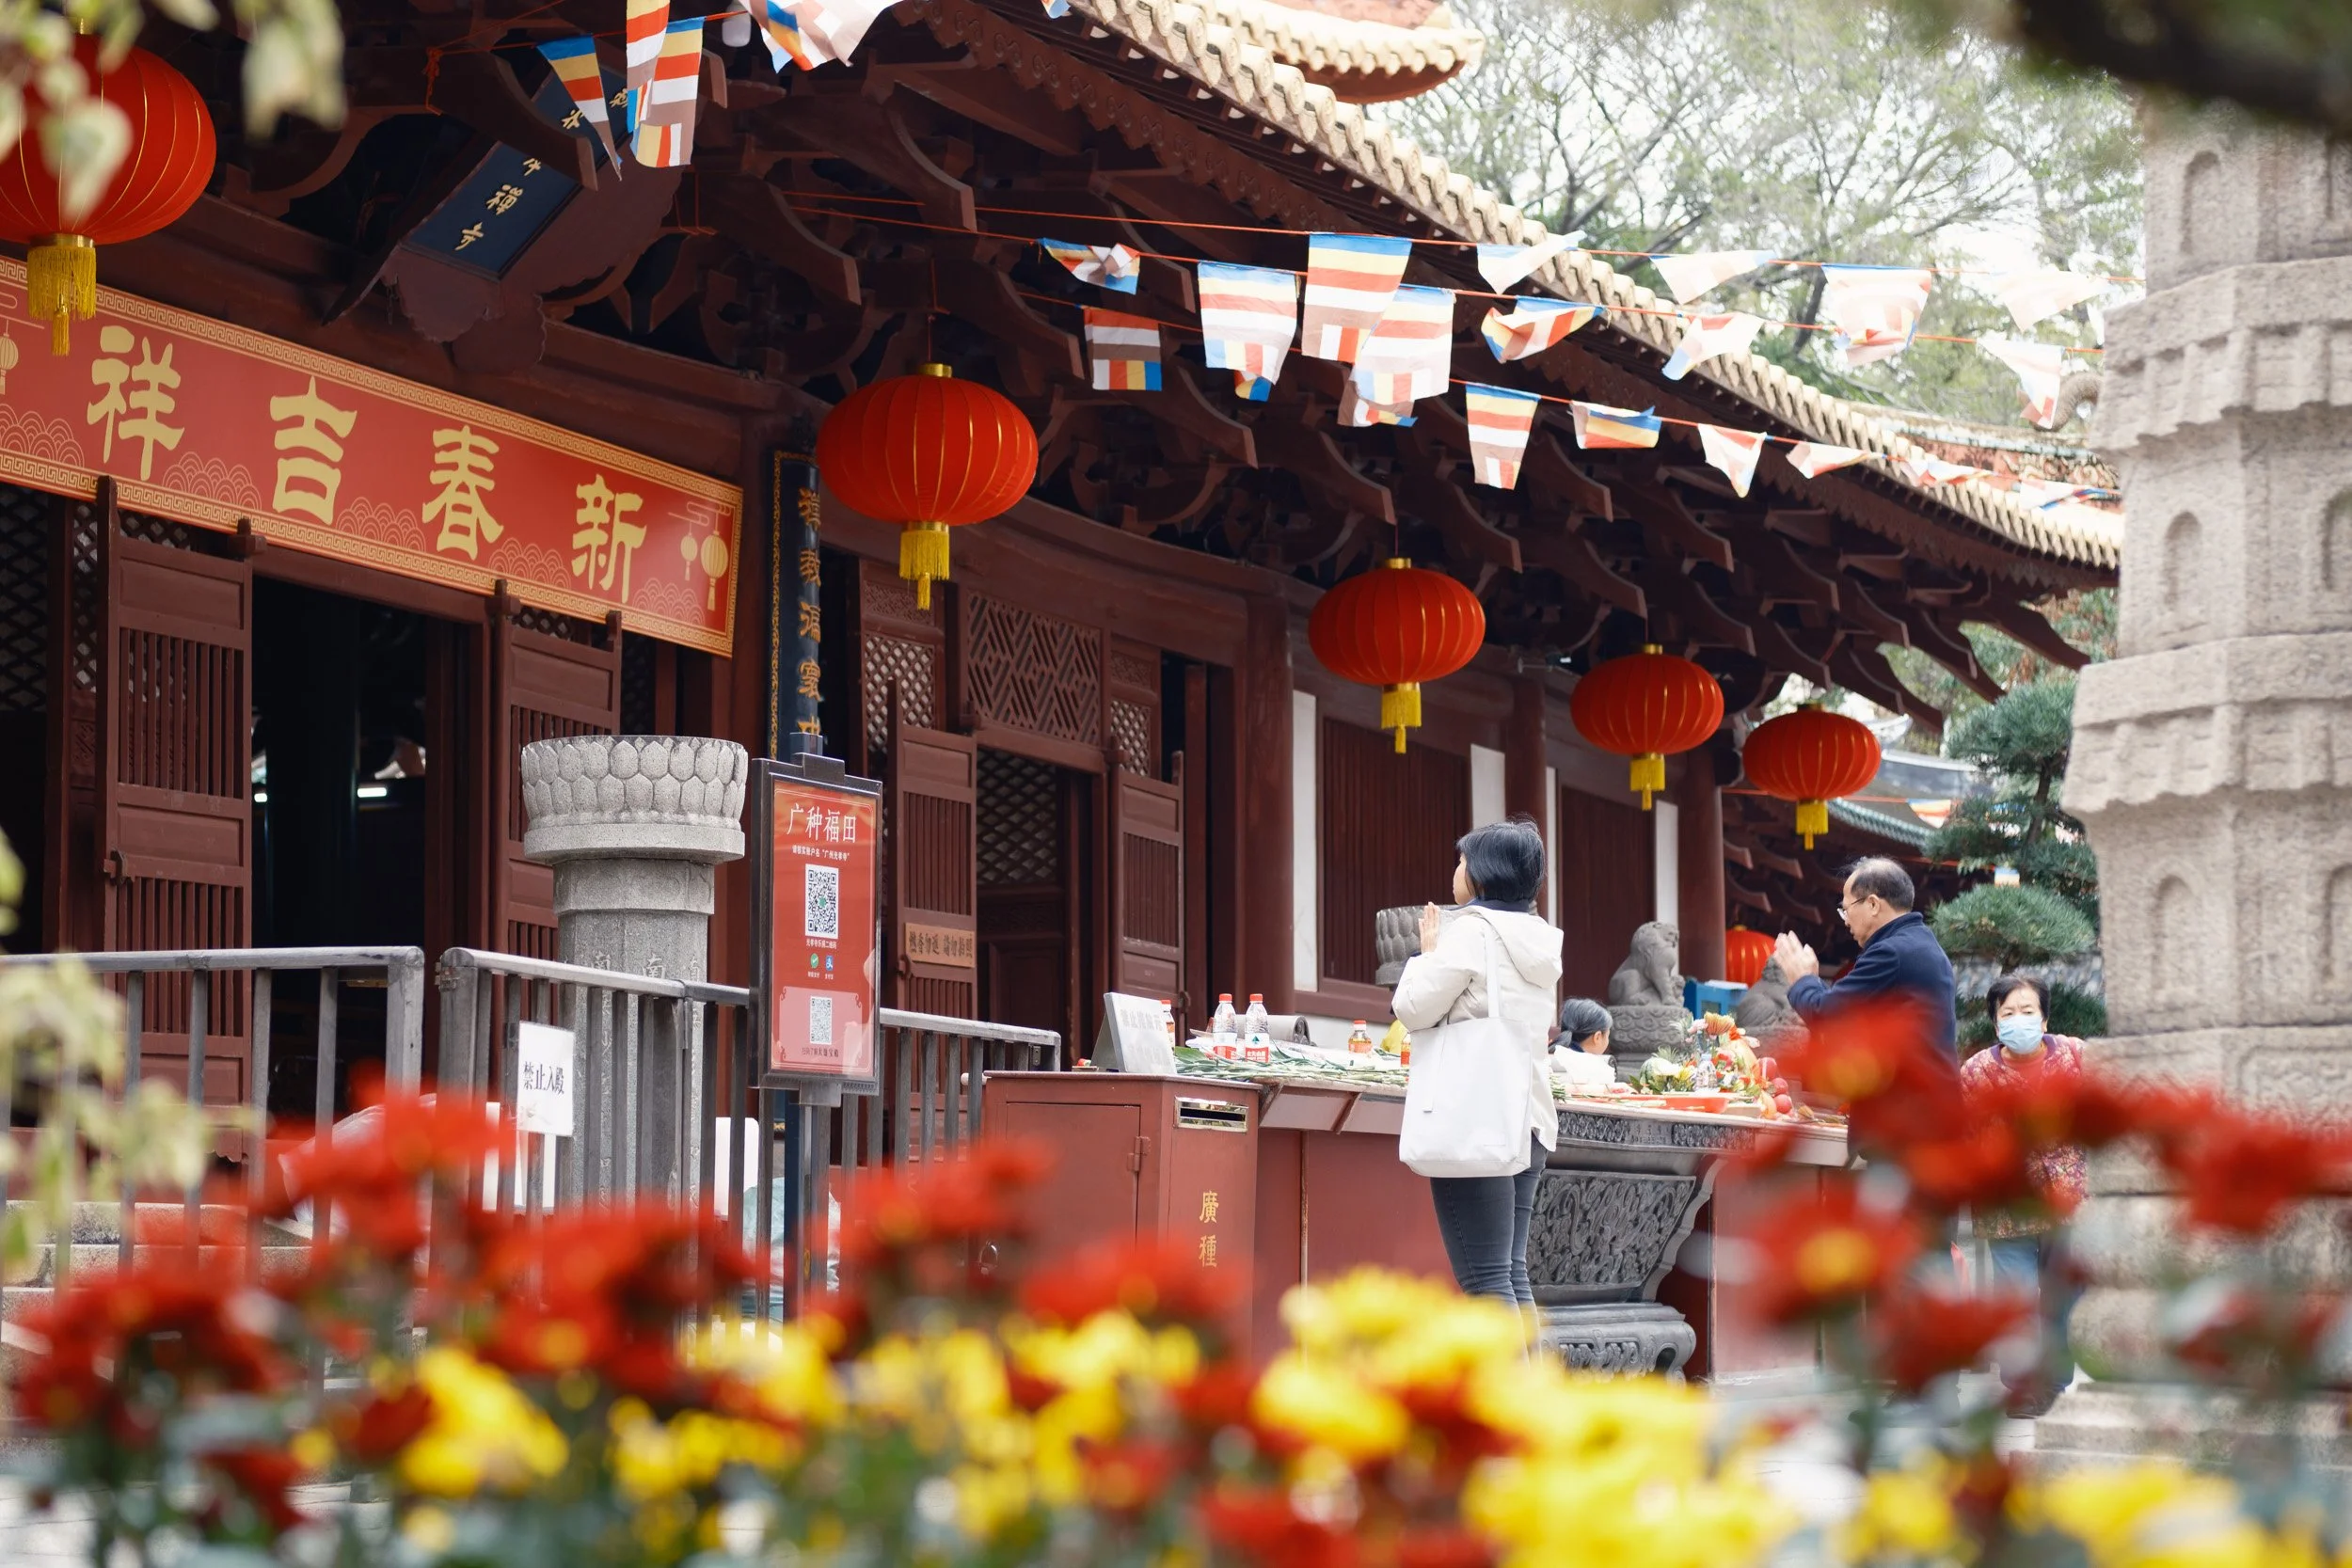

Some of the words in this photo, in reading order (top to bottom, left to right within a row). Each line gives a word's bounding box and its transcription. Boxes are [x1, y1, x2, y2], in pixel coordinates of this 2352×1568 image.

[787, 802, 857, 844] 广种福田
[523, 1061, 564, 1095] 禁止入殿
[1199, 1190, 1219, 1268] 廣種
